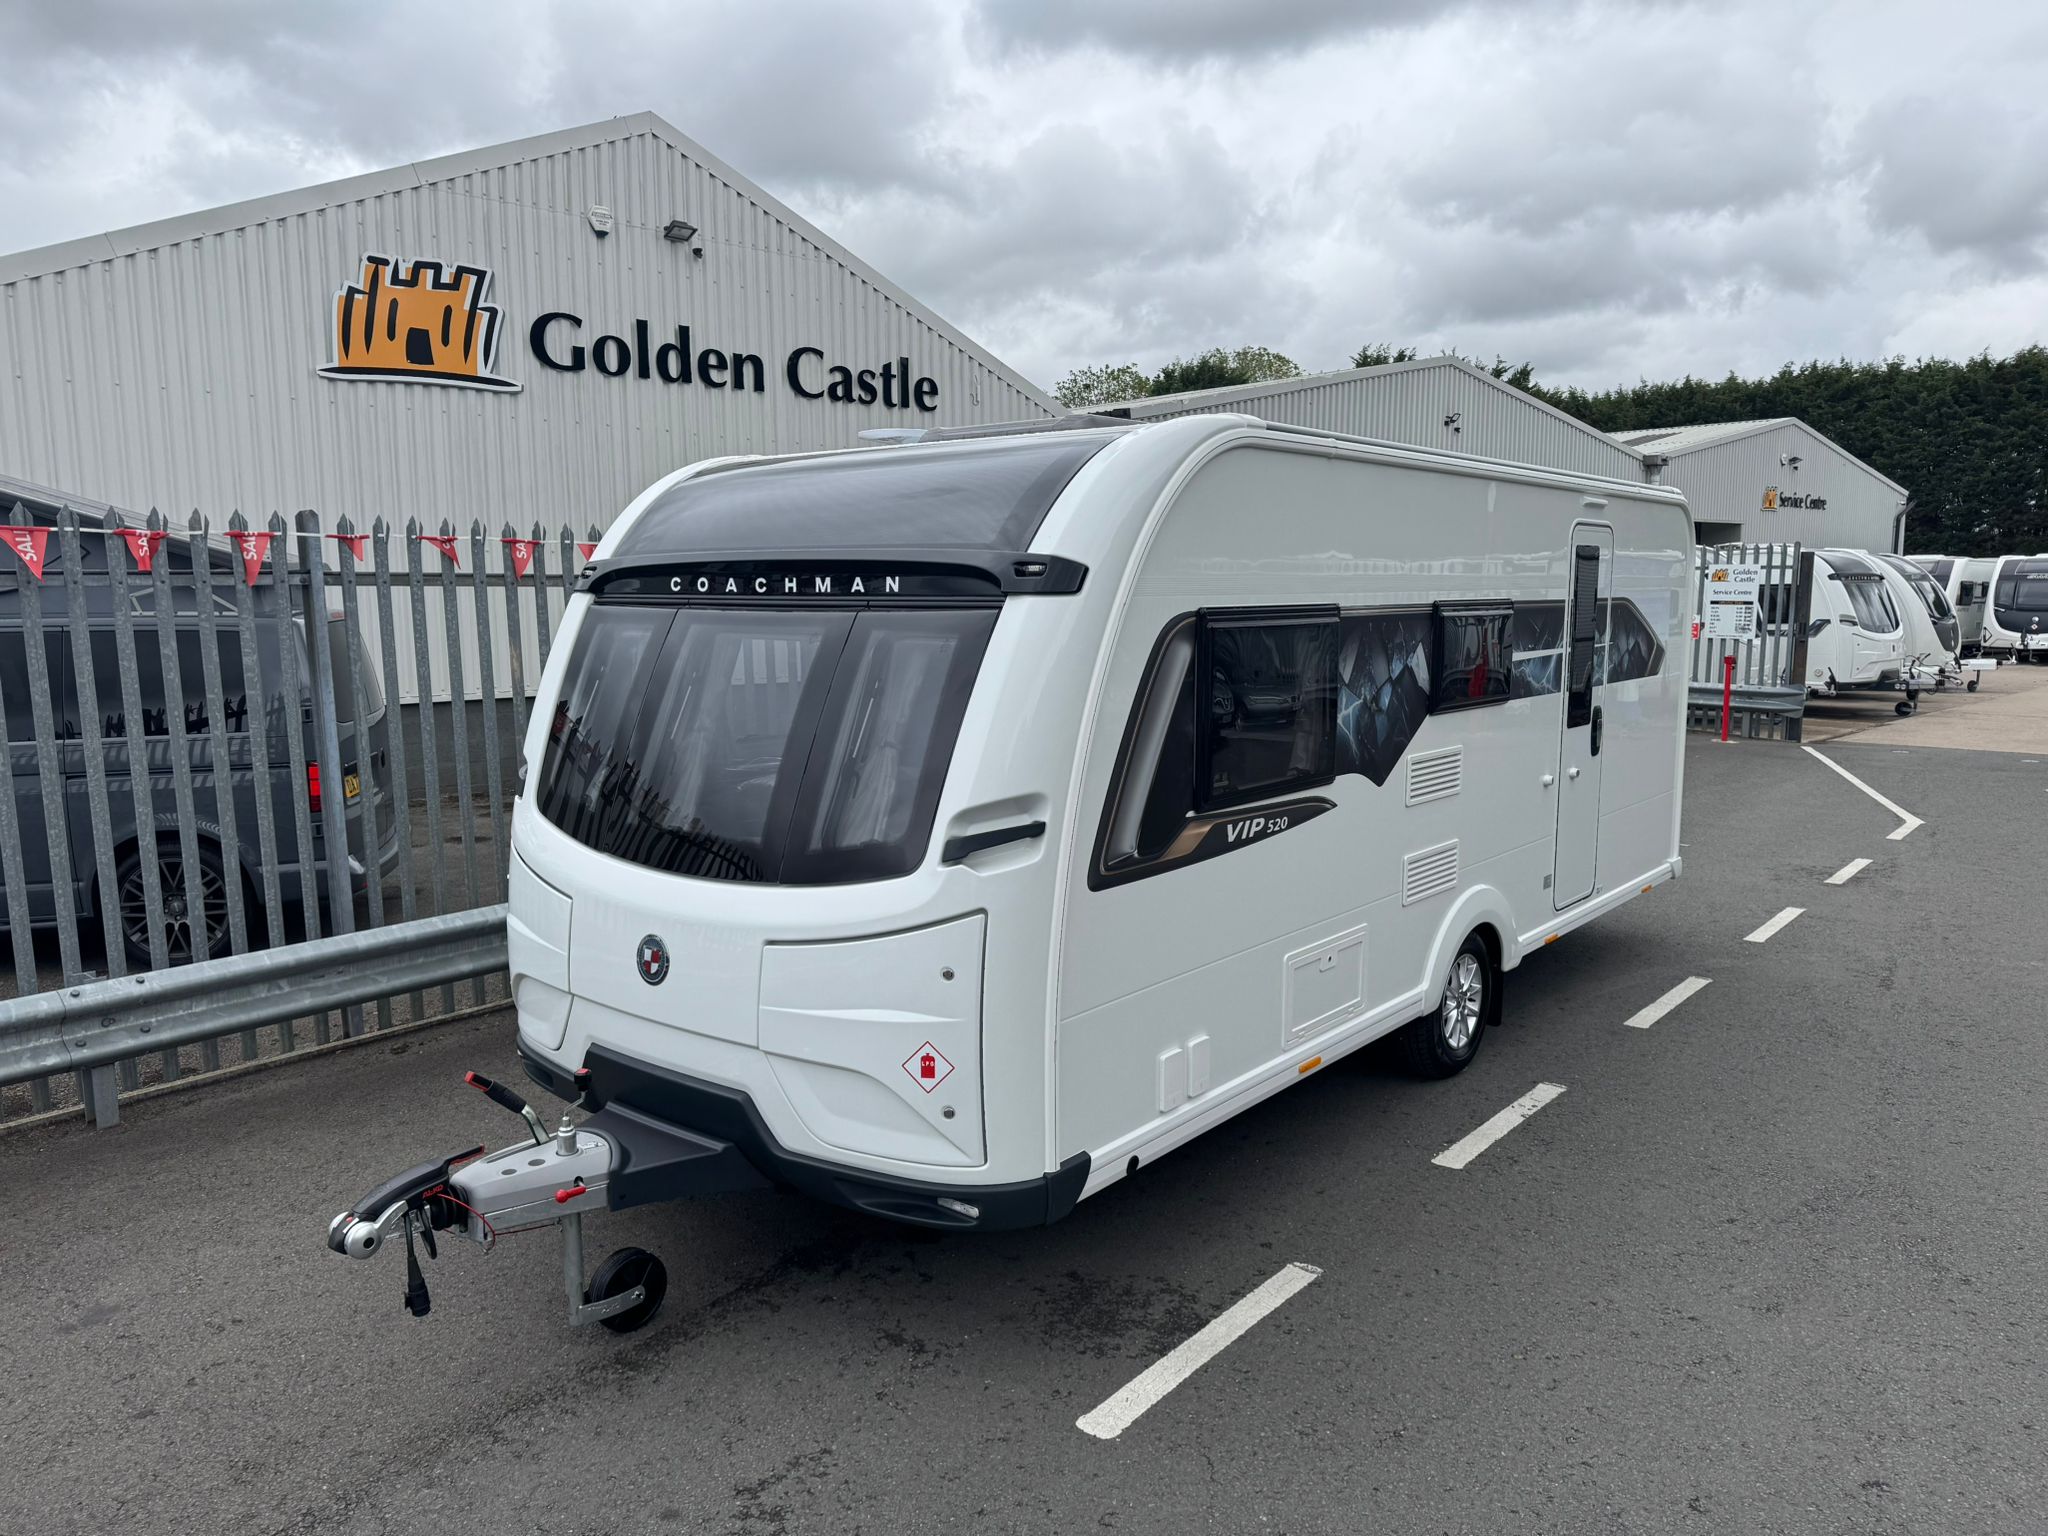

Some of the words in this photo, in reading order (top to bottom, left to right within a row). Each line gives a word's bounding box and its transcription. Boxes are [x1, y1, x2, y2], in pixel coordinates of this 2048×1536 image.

[529, 311, 766, 393] Golden
[786, 345, 939, 412] Castle
[1779, 491, 1804, 509] Service
[1804, 493, 1827, 511] Centre
[13, 530, 38, 562] SAL
[1732, 568, 1758, 576] Golden
[670, 576, 900, 593] COACHMAN
[1226, 817, 1266, 843] VIP
[1267, 816, 1288, 833] 520
